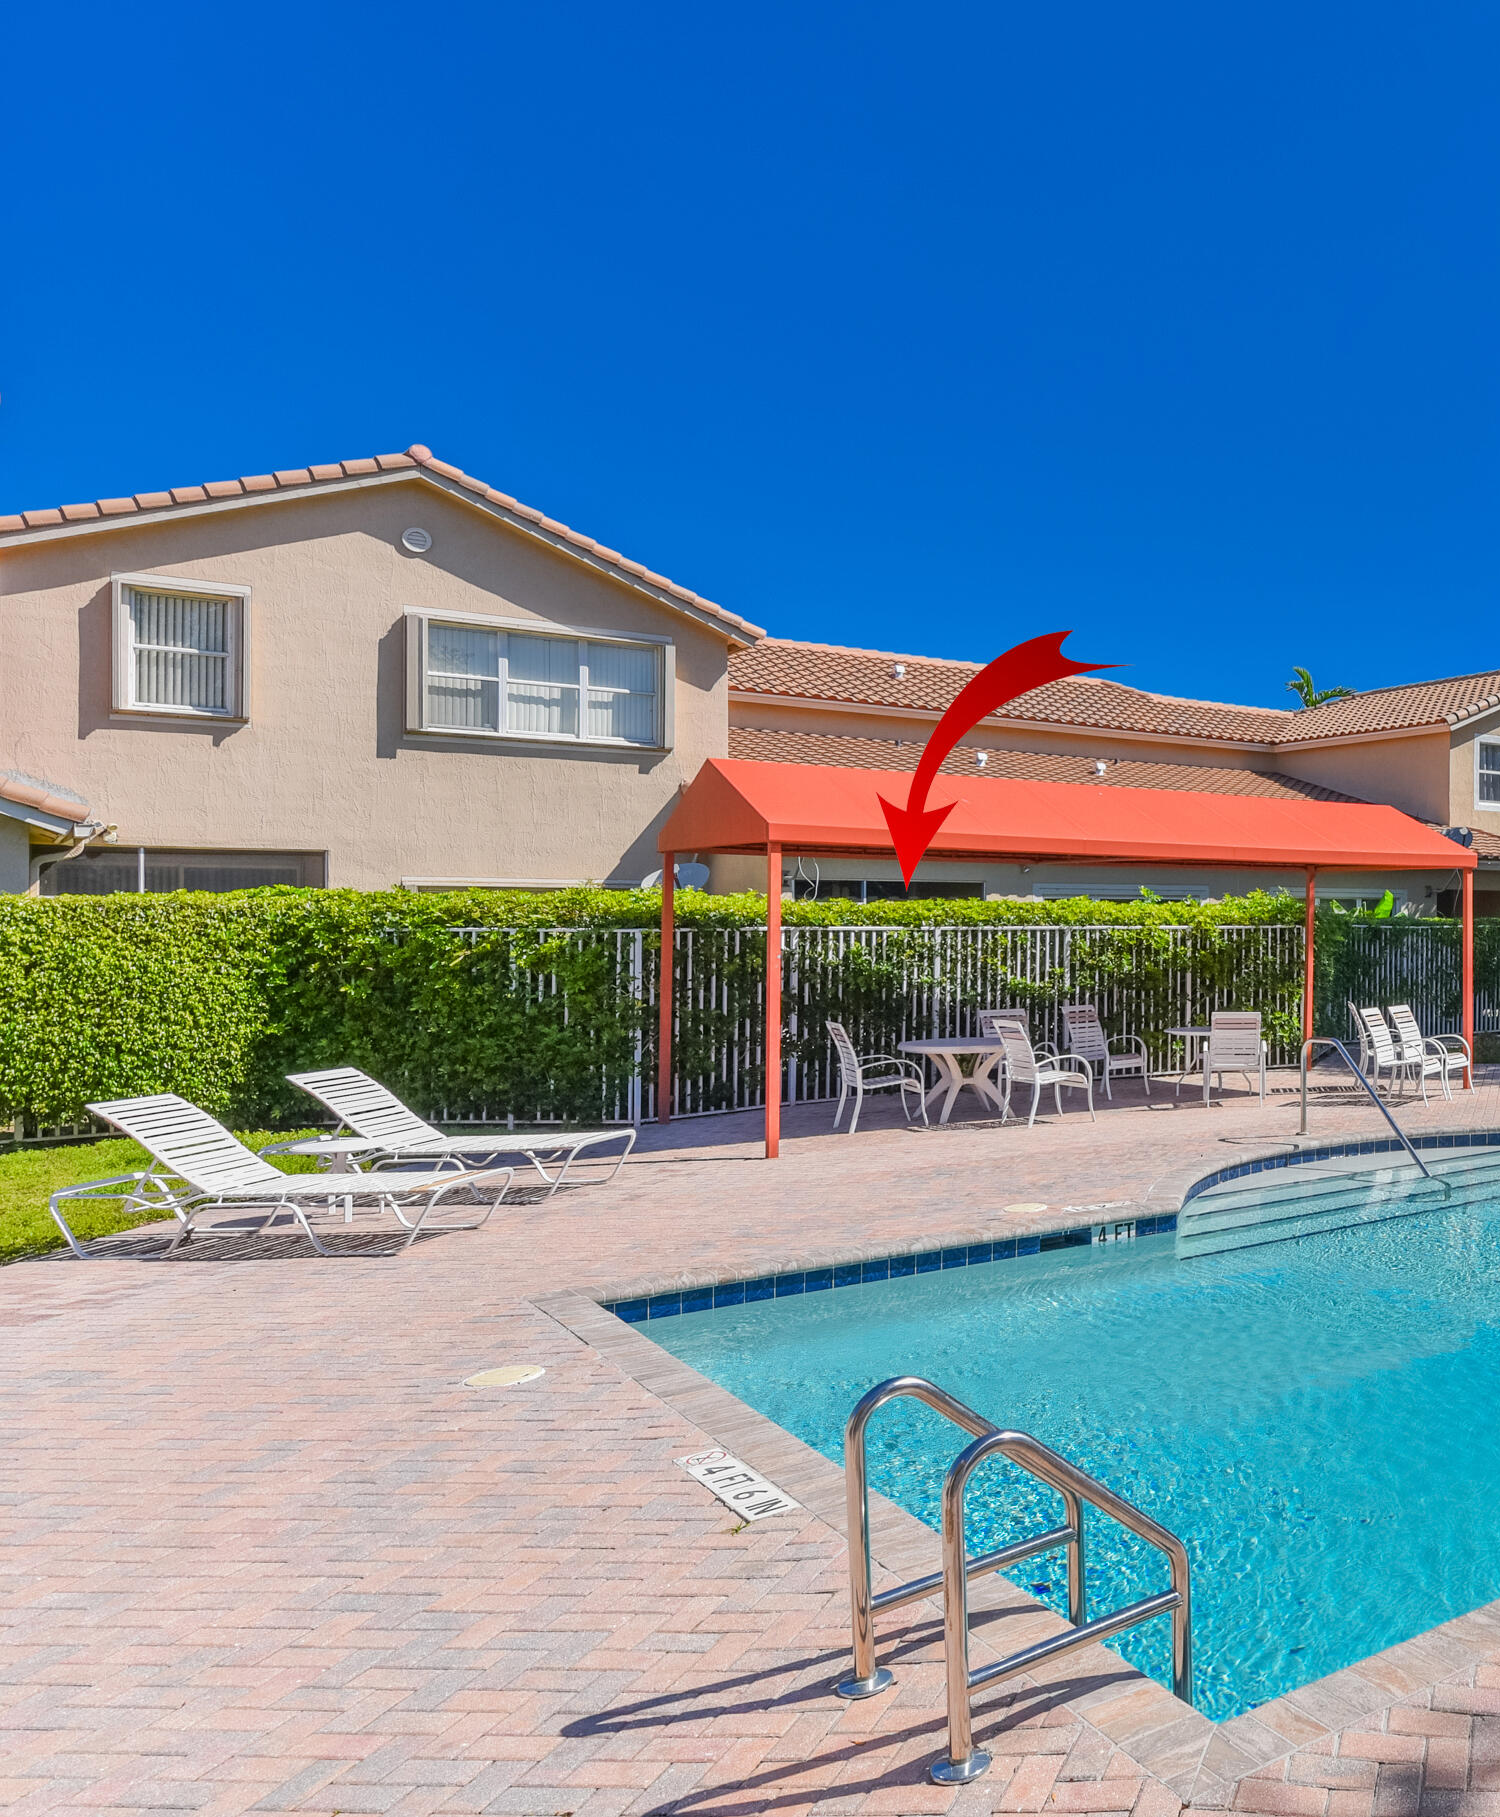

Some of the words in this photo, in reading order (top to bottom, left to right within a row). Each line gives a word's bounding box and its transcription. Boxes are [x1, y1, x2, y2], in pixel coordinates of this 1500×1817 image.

[1098, 1226, 1107, 1242] 4
[1115, 1222, 1134, 1240] FT
[702, 1465, 736, 1476] 4
[712, 1473, 755, 1489] FT
[733, 1490, 768, 1500] 6
[745, 1498, 789, 1516] IN
